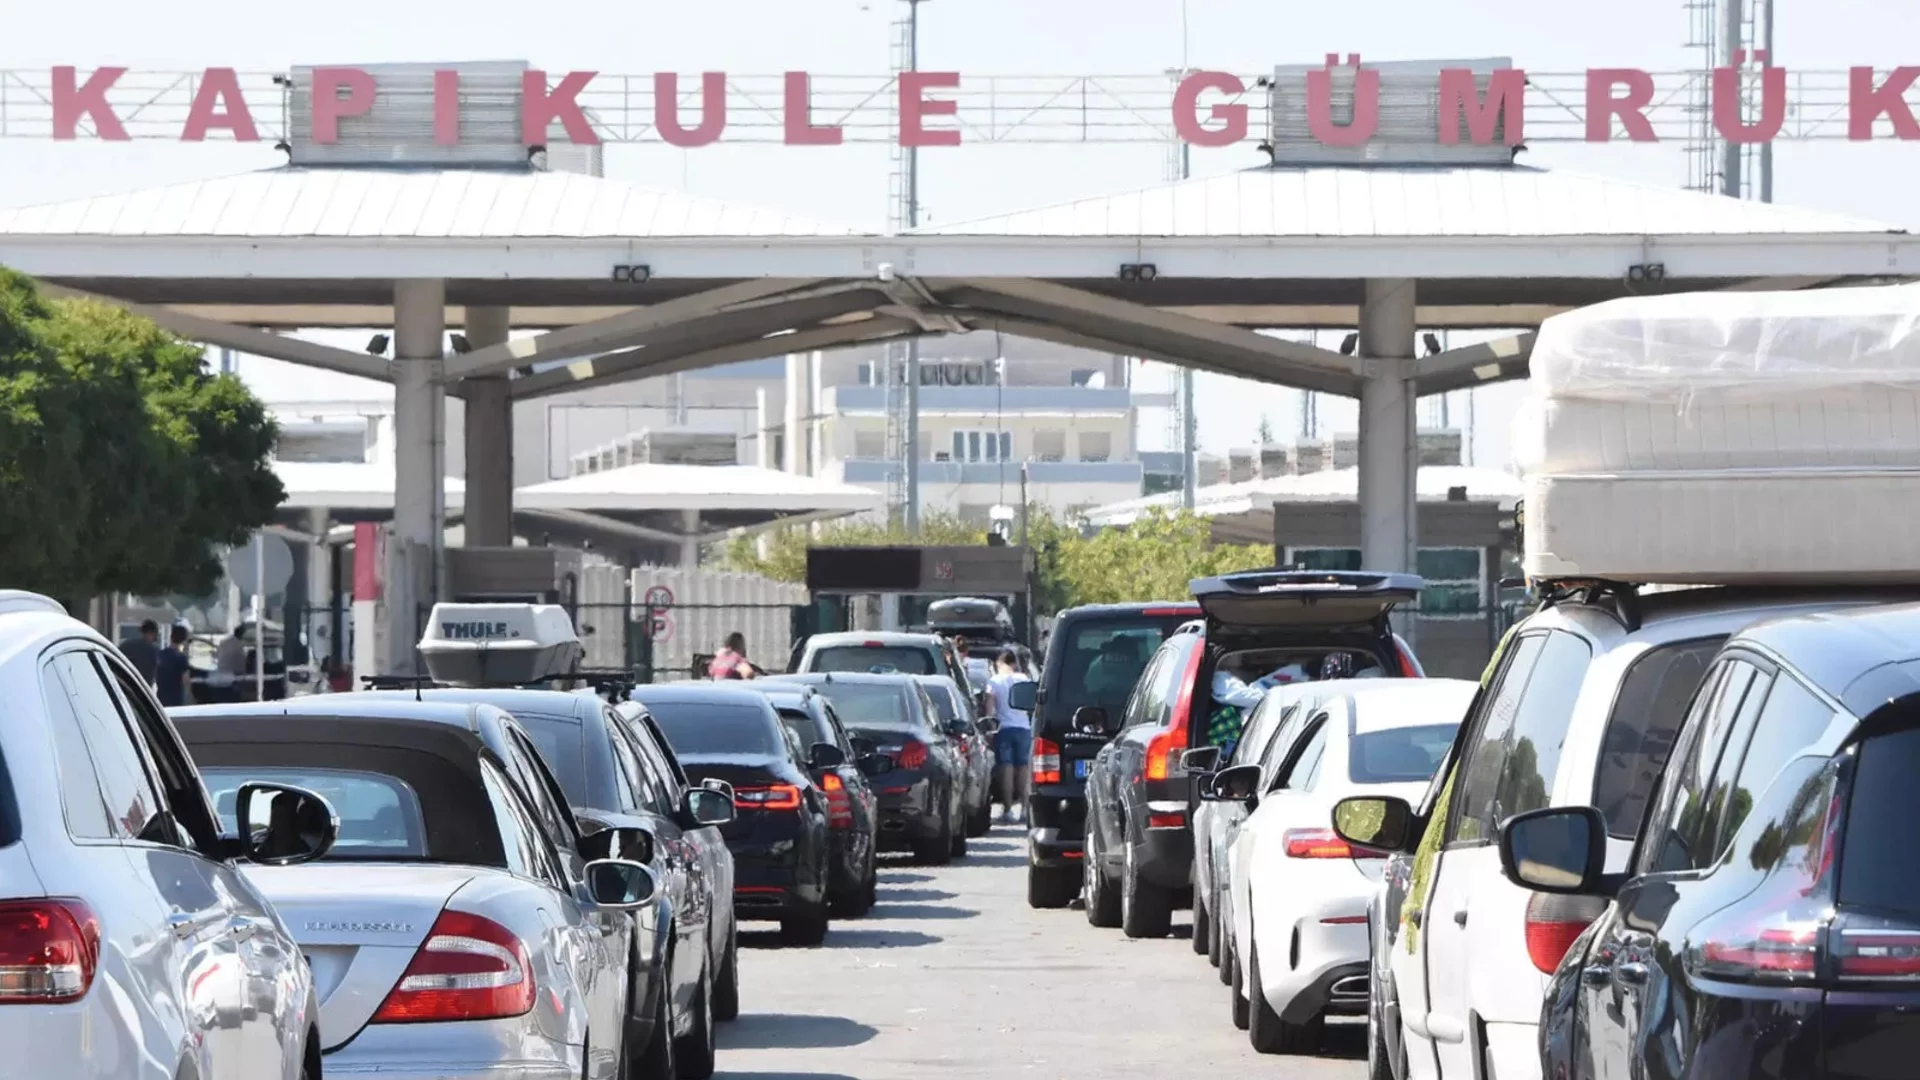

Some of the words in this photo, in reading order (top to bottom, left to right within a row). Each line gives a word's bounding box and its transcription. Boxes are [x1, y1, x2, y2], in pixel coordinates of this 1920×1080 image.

[52, 65, 961, 147] KAPIKULE
[1172, 48, 1920, 147] GÜMRÜK
[441, 621, 507, 638] THULE
